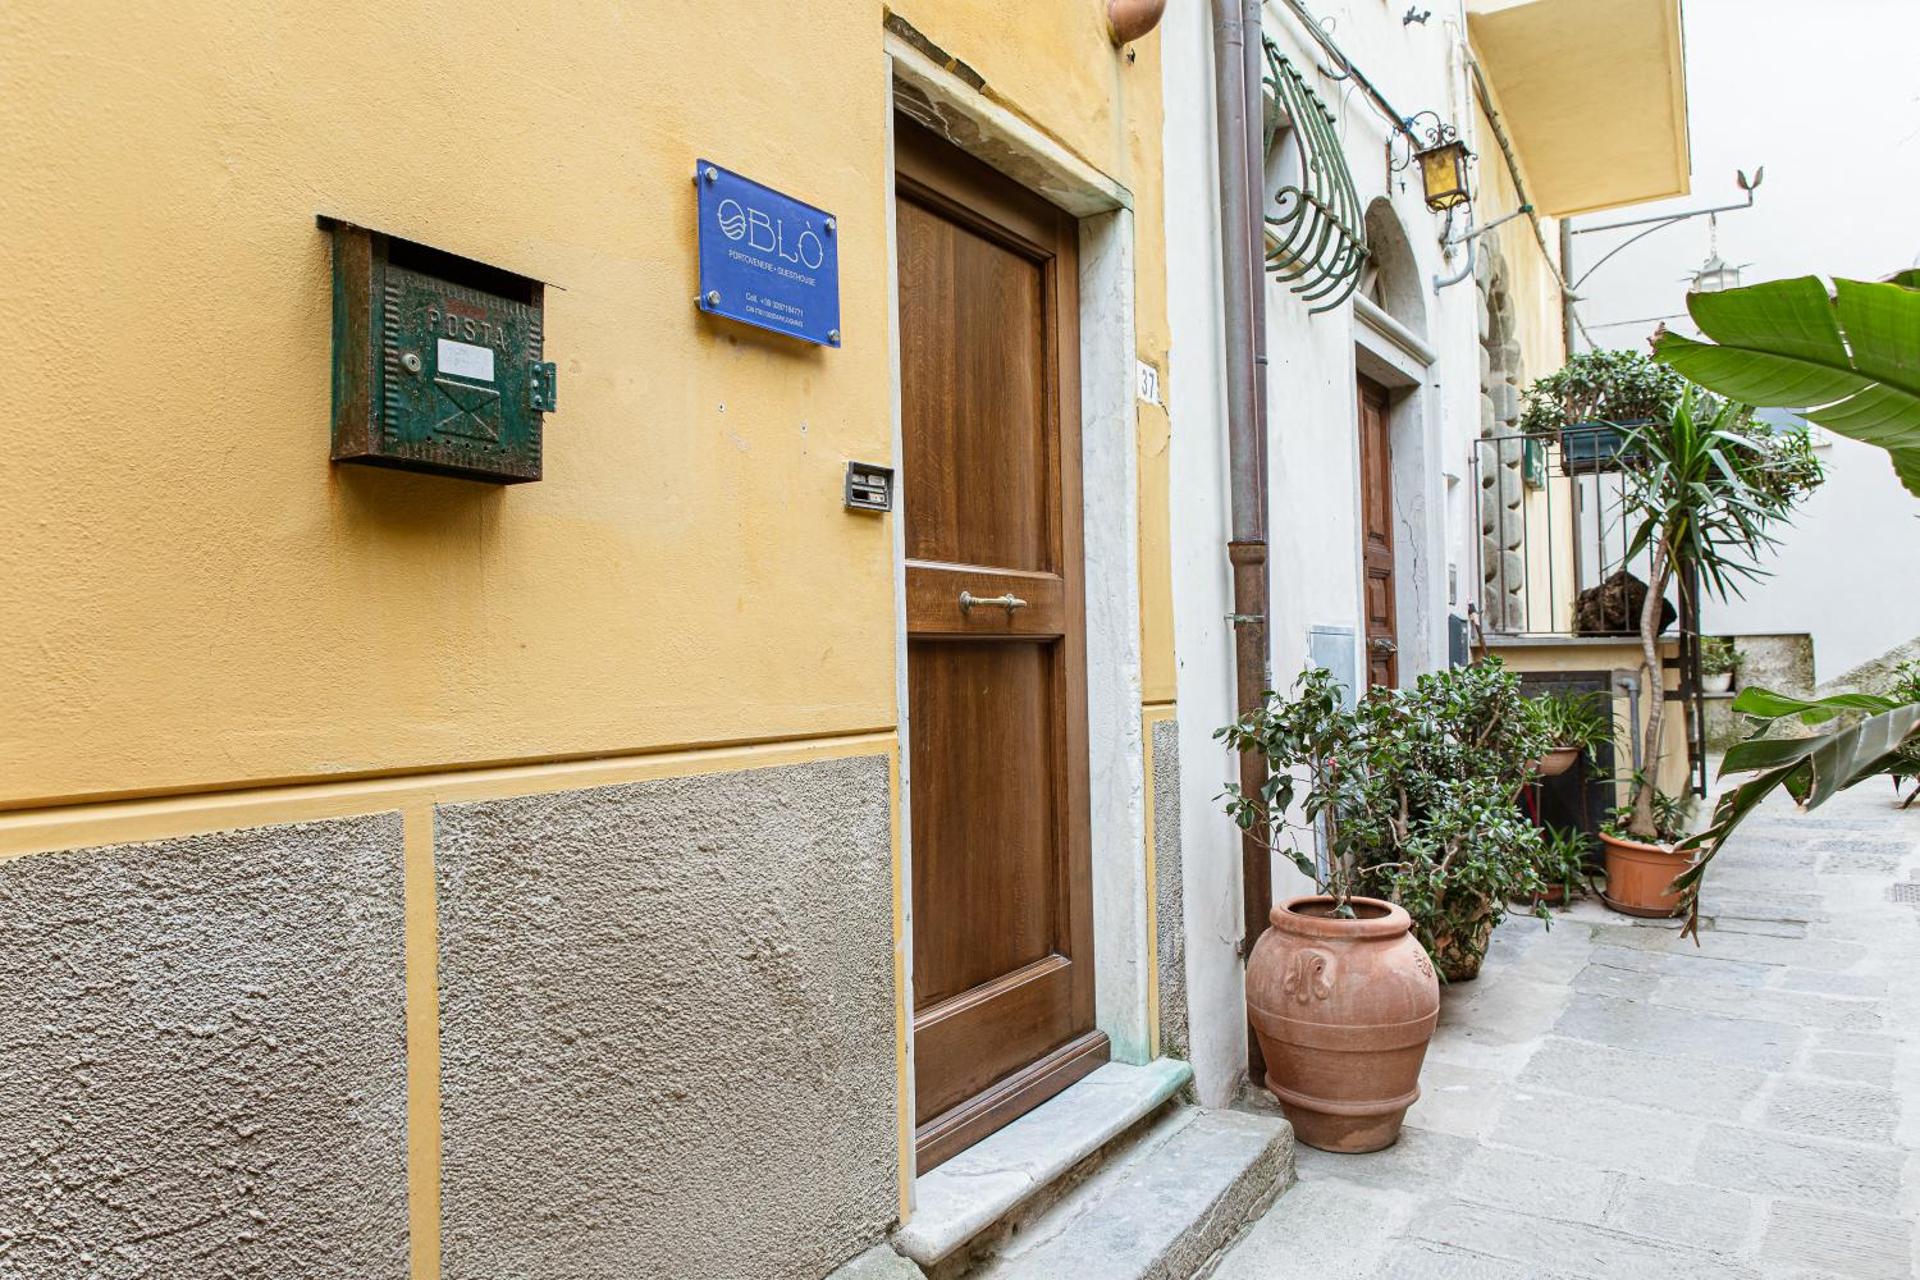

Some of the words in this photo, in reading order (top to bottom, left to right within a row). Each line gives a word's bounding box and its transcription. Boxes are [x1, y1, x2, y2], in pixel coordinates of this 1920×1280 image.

[717, 199, 823, 269] OBLÒ
[728, 249, 773, 272] PORTOVENERE
[777, 266, 816, 287] GUESTHOUSE
[427, 309, 507, 351] POSTA
[1142, 369, 1154, 398] 37
